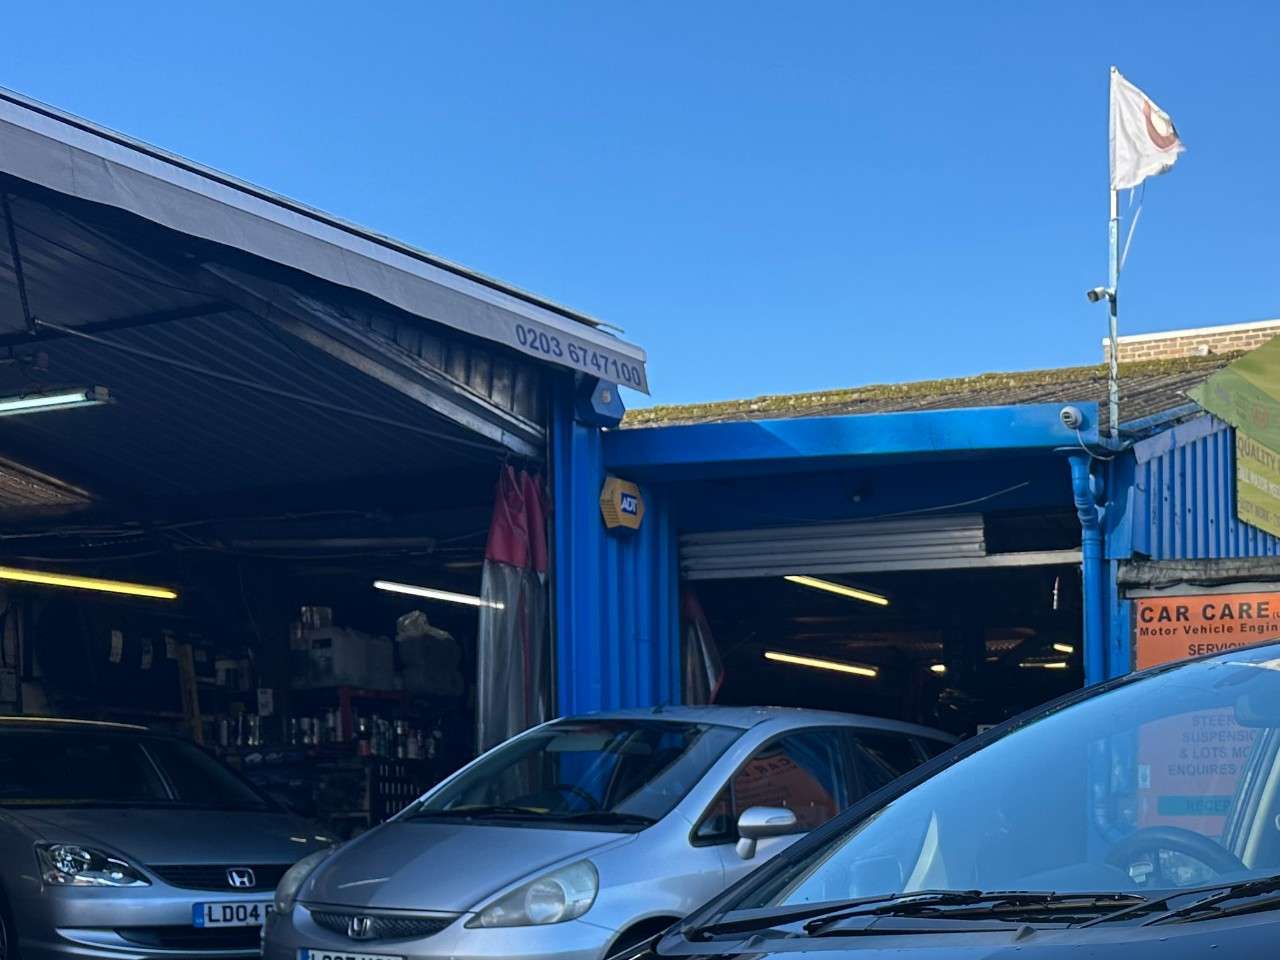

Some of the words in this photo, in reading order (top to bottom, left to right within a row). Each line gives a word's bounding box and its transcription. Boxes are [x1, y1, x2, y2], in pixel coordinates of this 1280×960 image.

[515, 324, 563, 357] 0203
[568, 343, 641, 386] 6747100
[1238, 437, 1275, 470] QUALITY
[621, 495, 637, 513] ADT
[1140, 605, 1190, 623] CAR
[1202, 601, 1270, 620] CARE
[1140, 627, 1177, 636] Motor
[1183, 625, 1234, 635] Vehicle
[1192, 747, 1227, 760] LOTS
[1167, 764, 1237, 776] ENQUIRES
[208, 904, 260, 923] LD04
